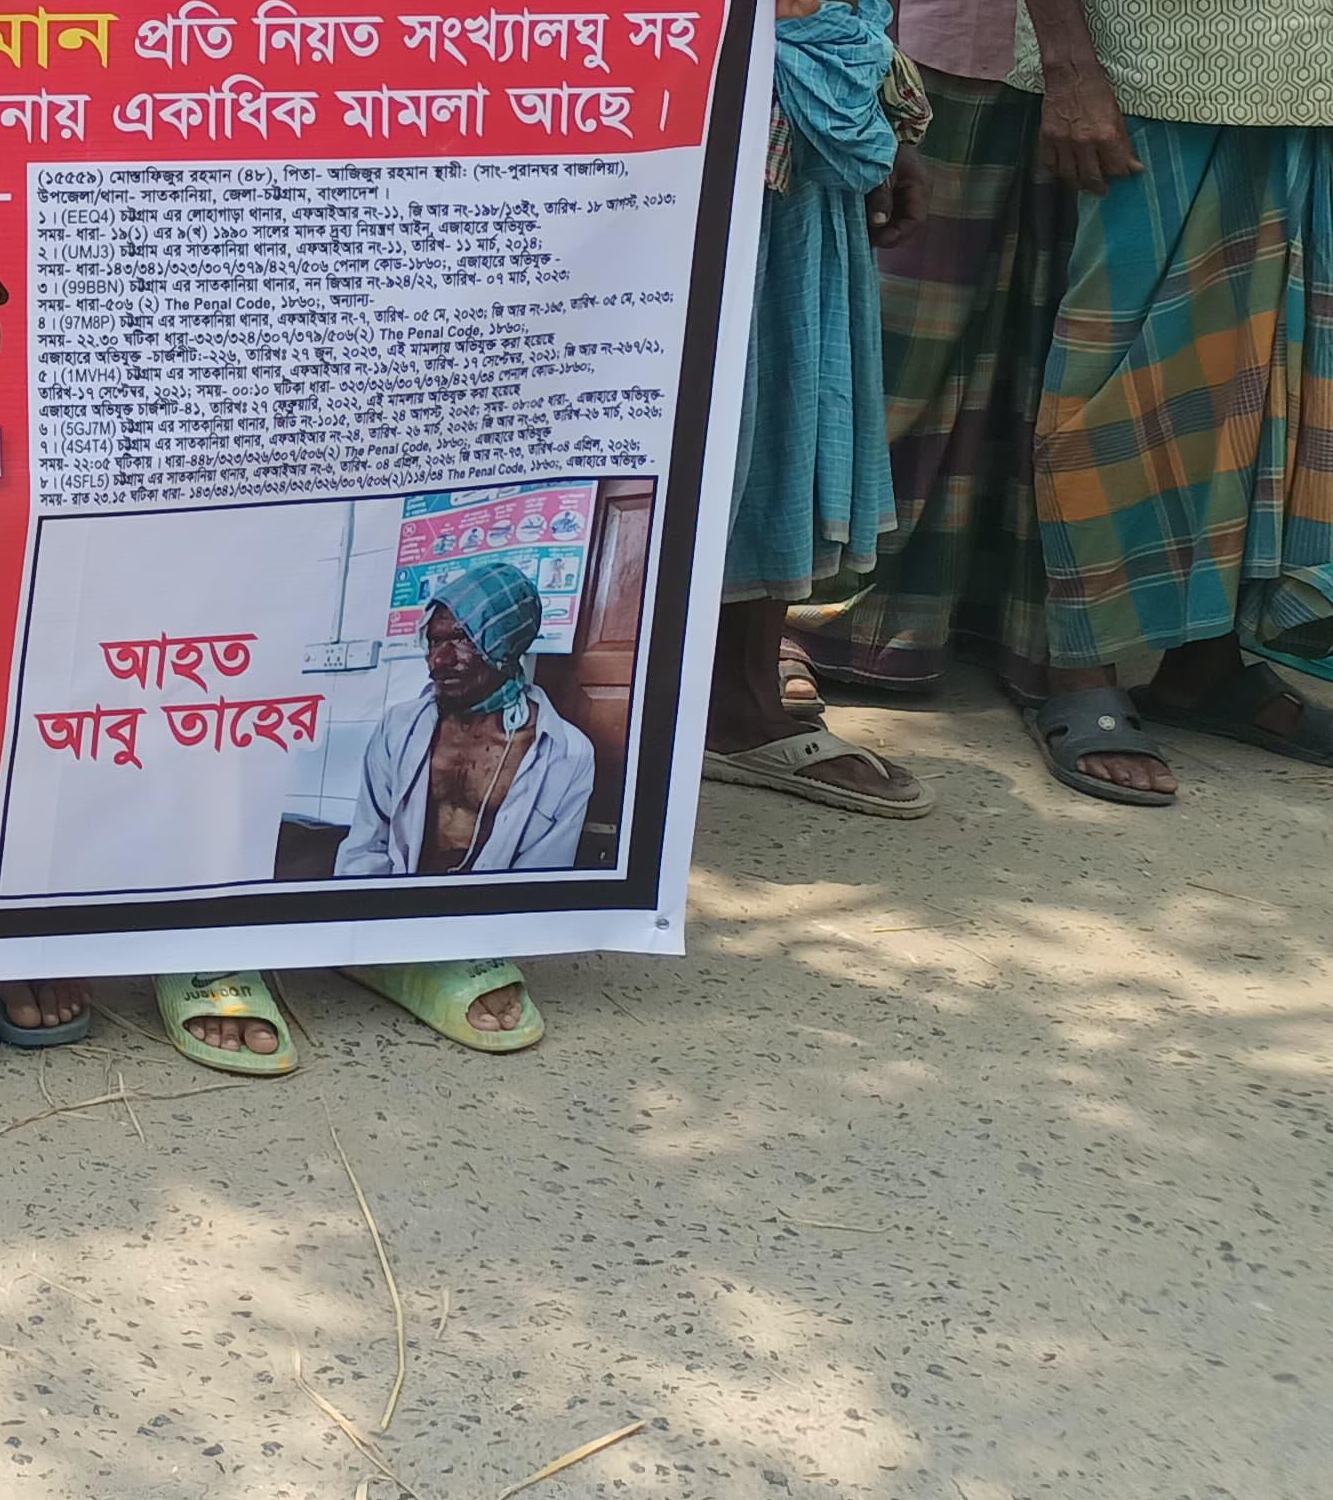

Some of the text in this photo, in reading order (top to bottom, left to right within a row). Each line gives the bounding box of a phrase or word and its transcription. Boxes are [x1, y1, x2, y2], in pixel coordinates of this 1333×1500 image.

[134, 0, 236, 68] প্রতি
[253, 0, 383, 63] নিয়ত
[401, 6, 607, 74] সংখ্যালঘু
[624, 8, 701, 65] সহ
[112, 74, 320, 141] একাধিক
[335, 82, 490, 140] মামলা
[506, 81, 637, 140] আছে
[38, 164, 428, 190] (১৫৫৫৯) রহমান (৪৮), পিতা- আজিজুর রহমান
[141, 185, 378, 204] সাতকানিয়া, বাংলাদেশ
[120, 204, 358, 224] চট্টগ্রাম এর লোহাগাড়া থানার, এফআইআর
[38, 219, 488, 242] সময়- ধারা- ১৯(১) এর ১৯৯০ সালের মাদক নিয়ন্ত্রণ আইন, এজাহারে
[120, 239, 363, 258] চট্টগ্রাম এর সাতকানিয়া থানার, এফআইআর
[38, 250, 551, 278] সময়- পেনাল এজাহারে অভিযুক্ত
[129, 273, 362, 293] চট্টগ্রাম এর সাতকানিয়া থানার, নন জিআর
[38, 296, 276, 314] সময়- ধারা-৫০৬ (২) The Penal Code,
[120, 310, 337, 329] চট্টগ্রাম এর সাতকানিয়া থানার, এফআইআর
[38, 324, 483, 347] সময়- ২২.৩০ ঘটিকা The Penal Code,
[38, 348, 309, 366] এজাহারে অভিযুক্ত ২৭
[127, 362, 350, 381] চট্টগ্রাম এর সাতকানিয়া থানার, এফআইআর
[275, 378, 305, 395] ঘটিকা
[39, 399, 133, 418] এজাহারে অভিযুক্ত
[121, 412, 296, 434] চট্টগ্রাম এর সাতকানিয়া থানার, জিডি
[117, 428, 325, 452] চট্টগ্রাম এর সাতকানিয়া থানার, এফআইআর
[39, 441, 431, 471] সময়- ঘটিকায় The Penal Code,
[40, 462, 526, 507] সময়- রাত ঘটিকা The Penal Code,
[114, 467, 248, 486] চট্টগ্রাম এর সাতকানিয়া থানার,
[100, 633, 257, 691] আহত
[35, 694, 326, 769] আবু তাহের
